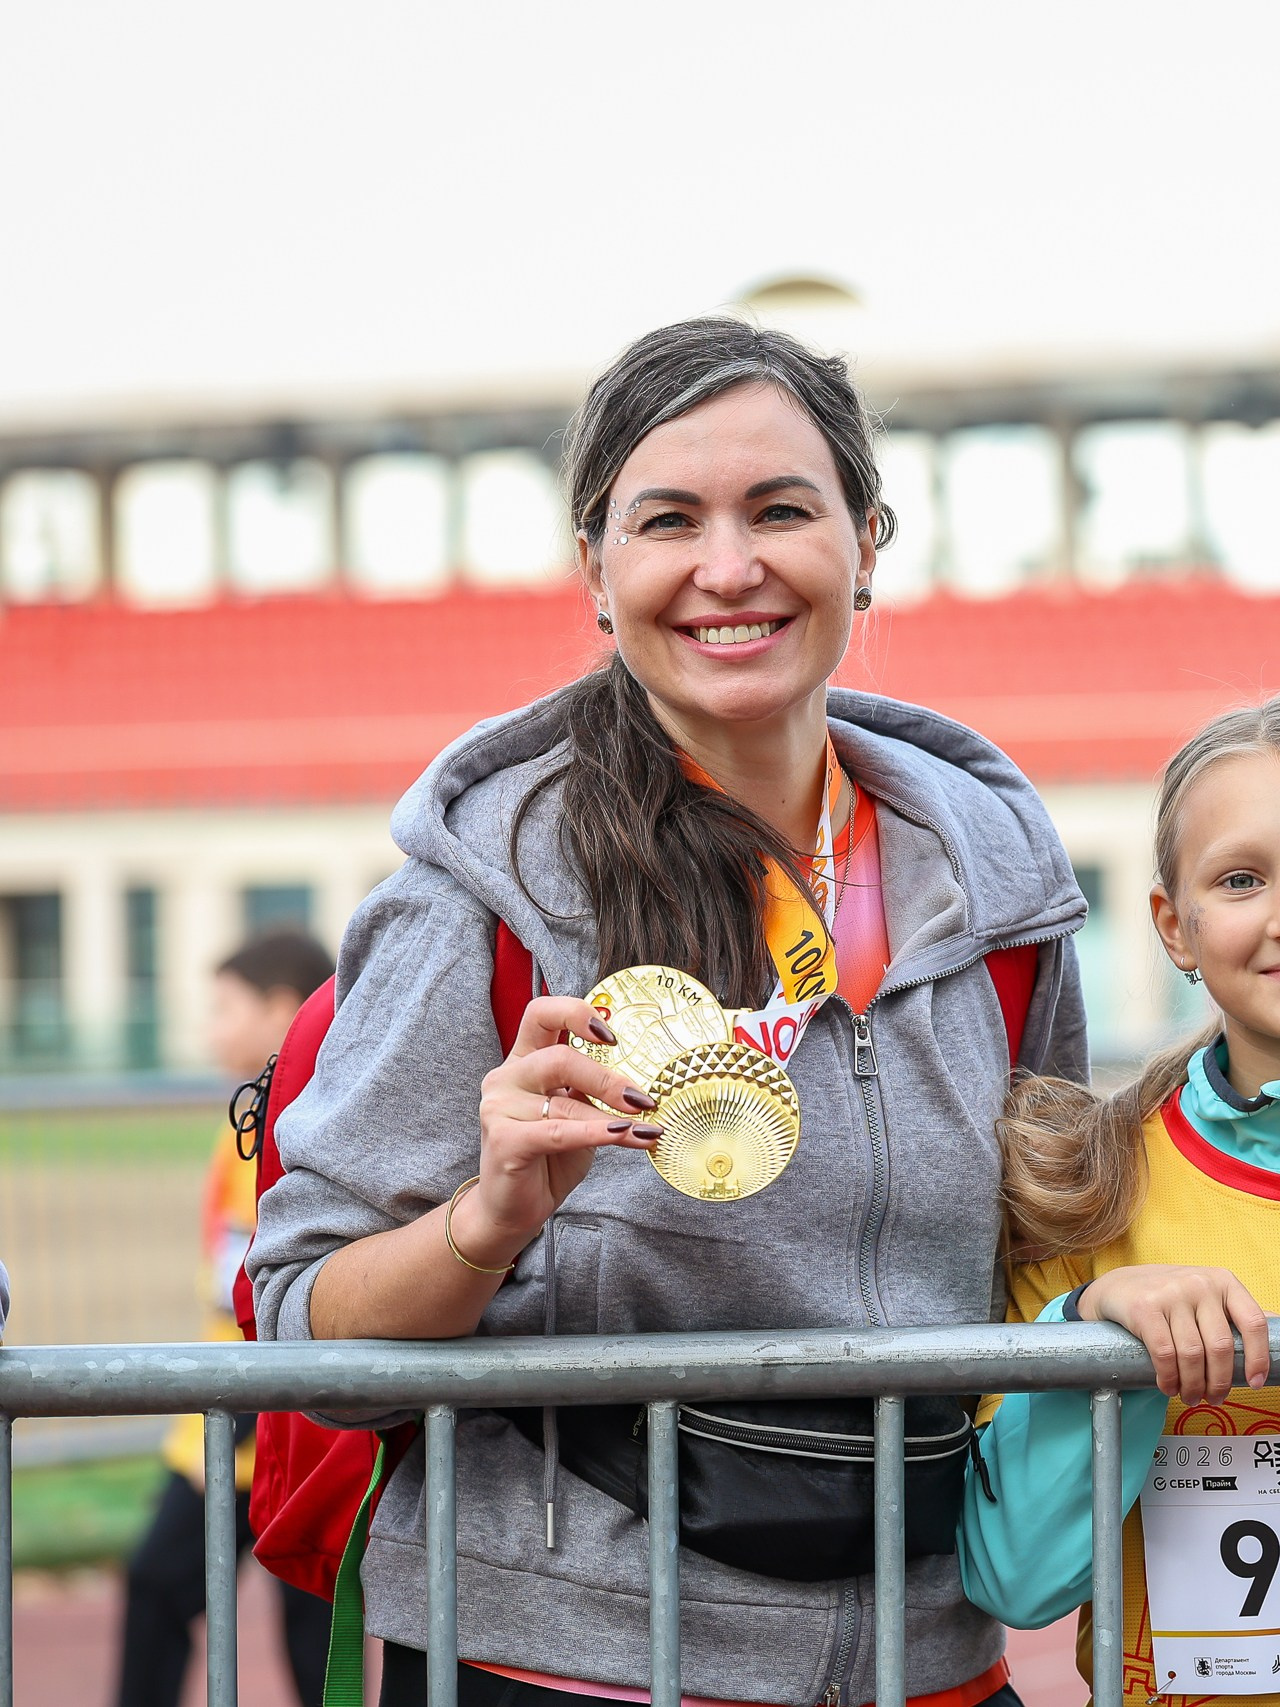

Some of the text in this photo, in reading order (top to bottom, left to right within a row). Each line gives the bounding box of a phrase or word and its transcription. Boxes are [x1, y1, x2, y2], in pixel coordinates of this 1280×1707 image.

[1154, 1446, 1233, 1467] 2026
[1169, 1479, 1232, 1489] СБЕР Прайм
[1214, 1657, 1250, 1665] Департамент
